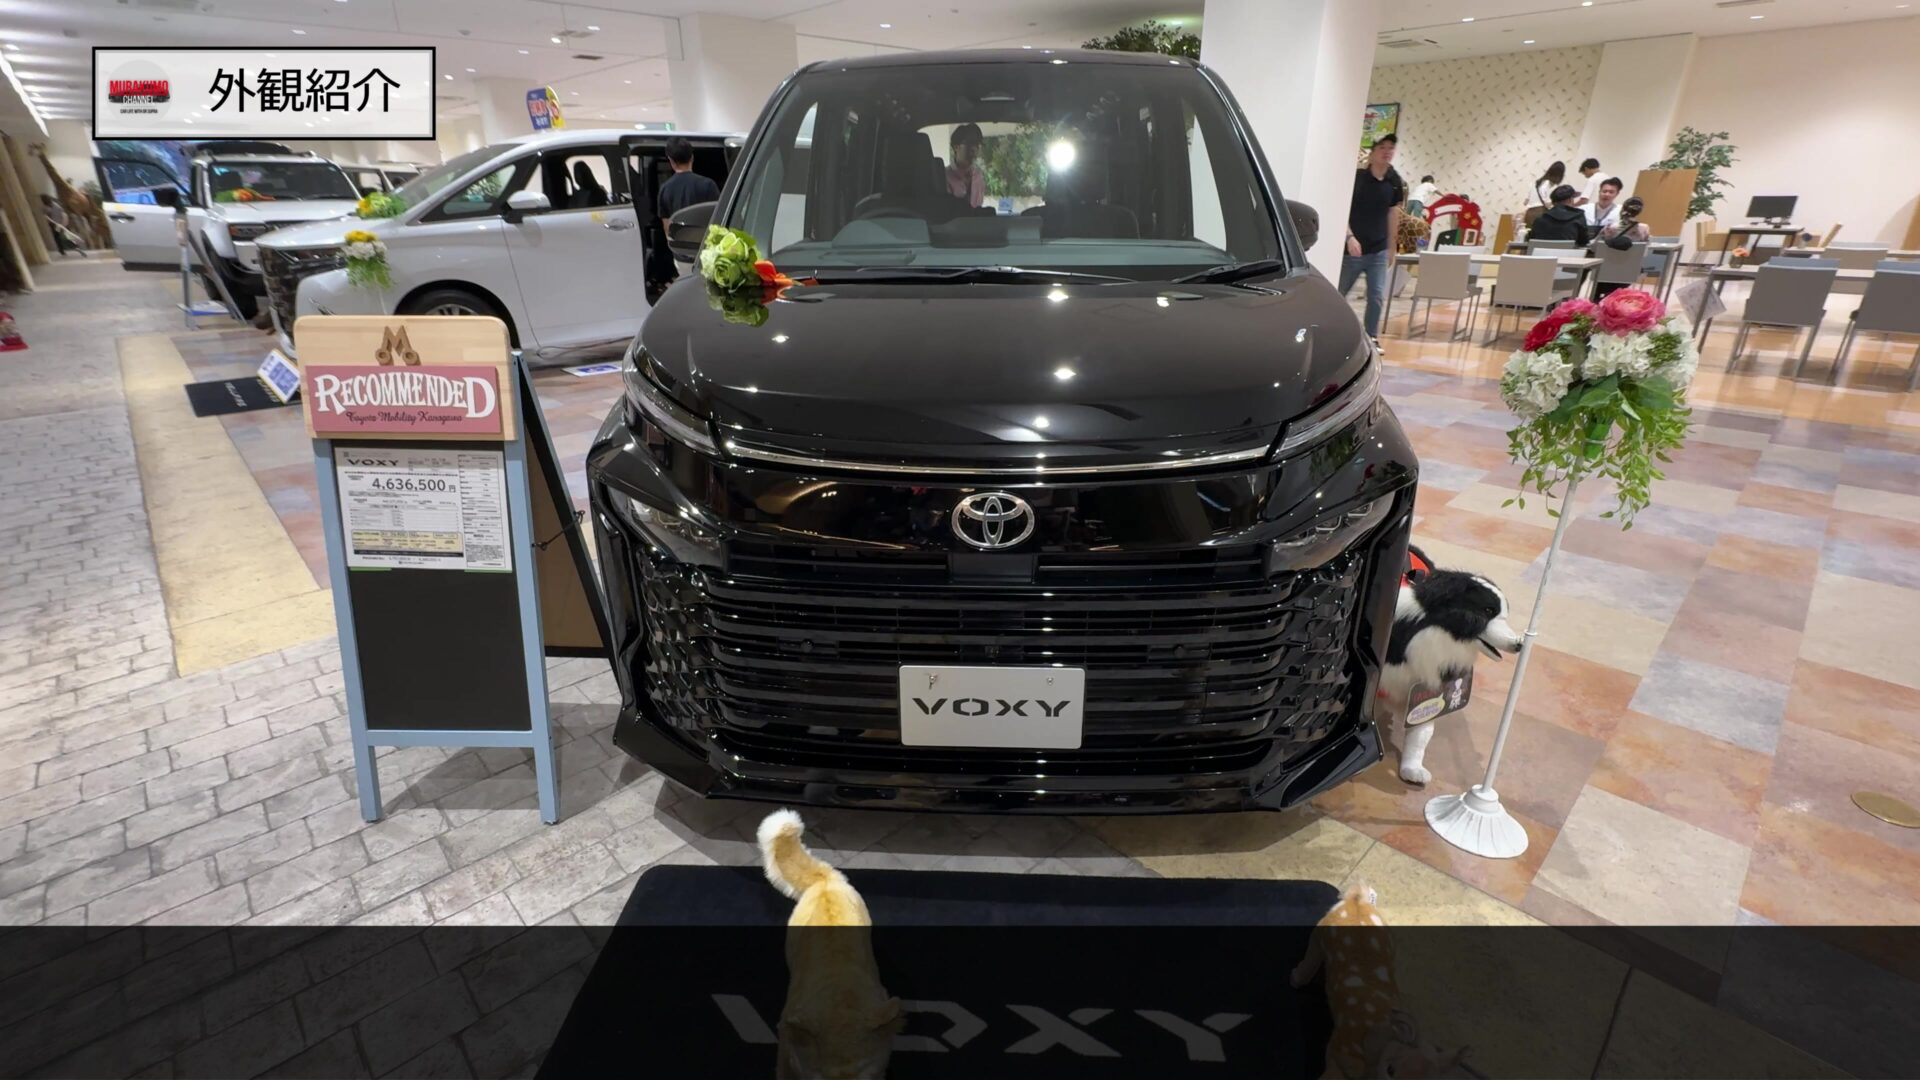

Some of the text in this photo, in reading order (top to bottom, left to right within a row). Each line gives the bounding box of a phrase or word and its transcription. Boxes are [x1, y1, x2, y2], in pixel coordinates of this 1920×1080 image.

[314, 372, 496, 418] RECOMMENDED
[346, 411, 463, 426] Toyota Mobility Kanagawa
[912, 697, 1071, 718] VOXY
